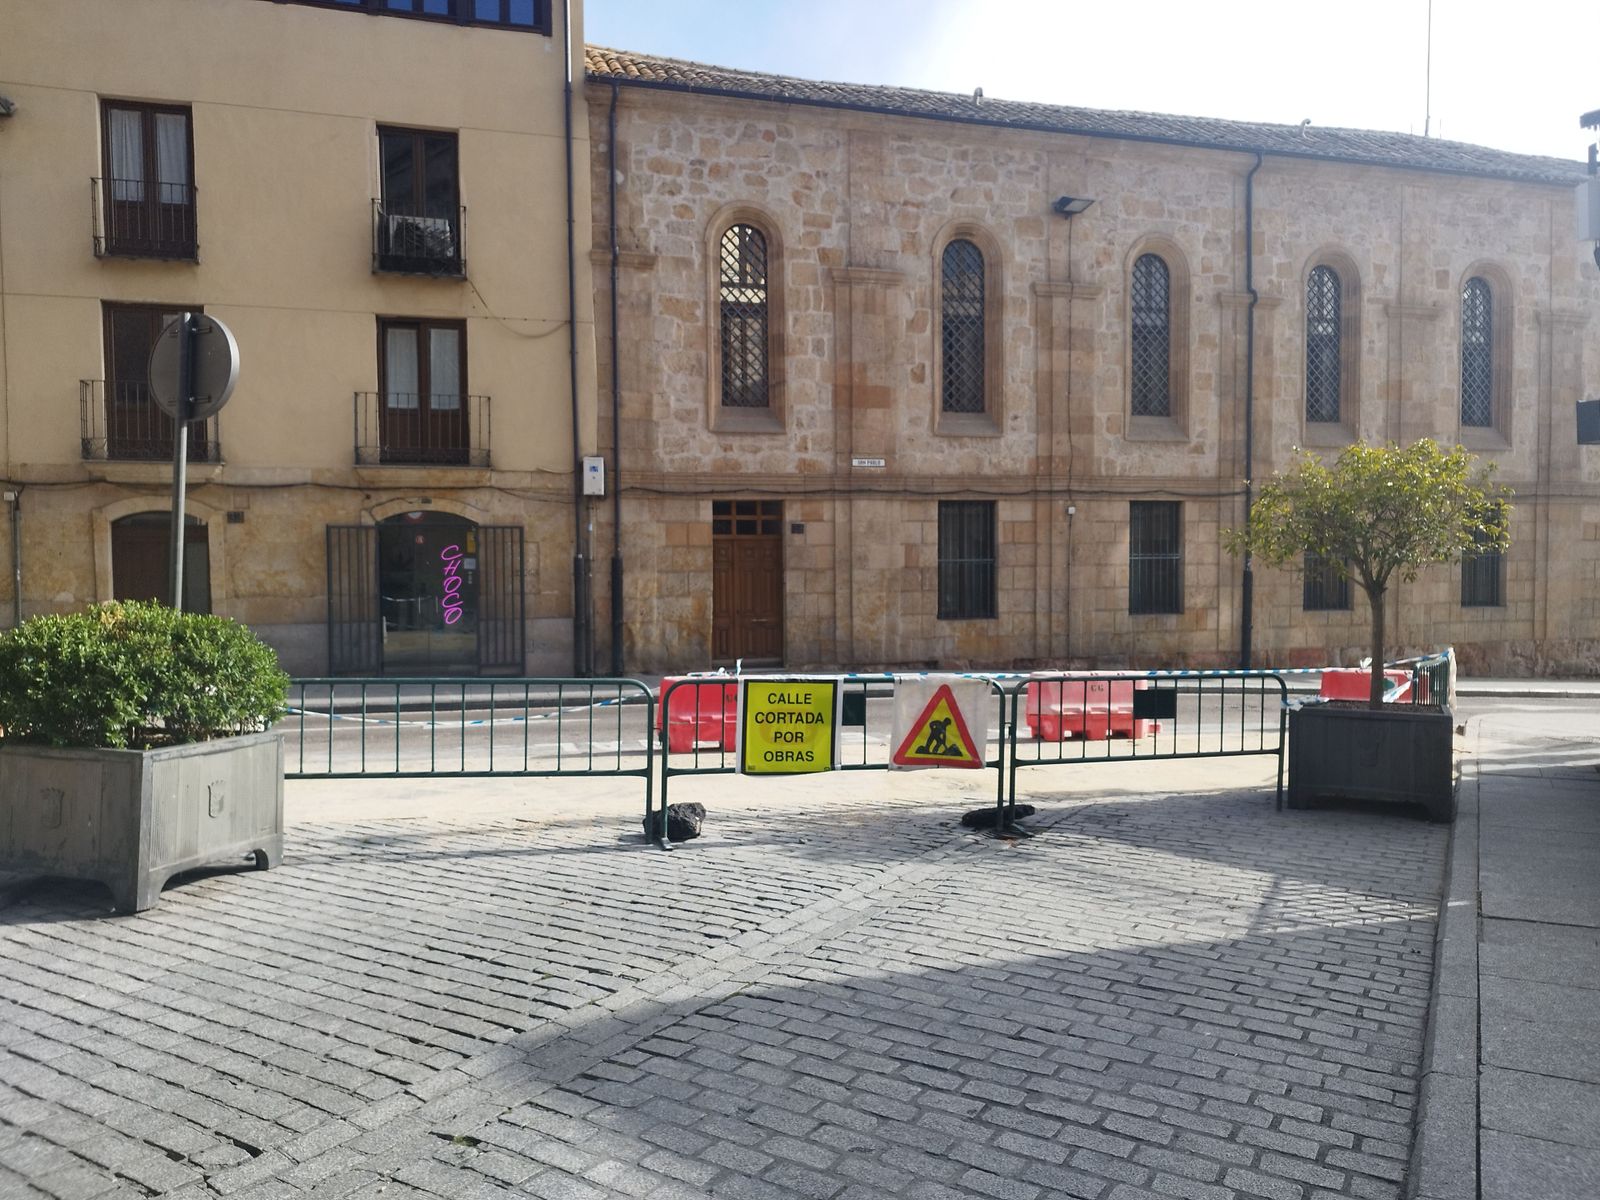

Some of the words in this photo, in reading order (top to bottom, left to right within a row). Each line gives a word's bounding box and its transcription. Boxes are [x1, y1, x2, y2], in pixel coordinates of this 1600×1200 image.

[441, 544, 463, 625] CHOCO
[767, 692, 812, 705] CALLE
[754, 711, 825, 724] CORTADA
[774, 731, 804, 743] POR
[763, 750, 815, 762] OBRAS
